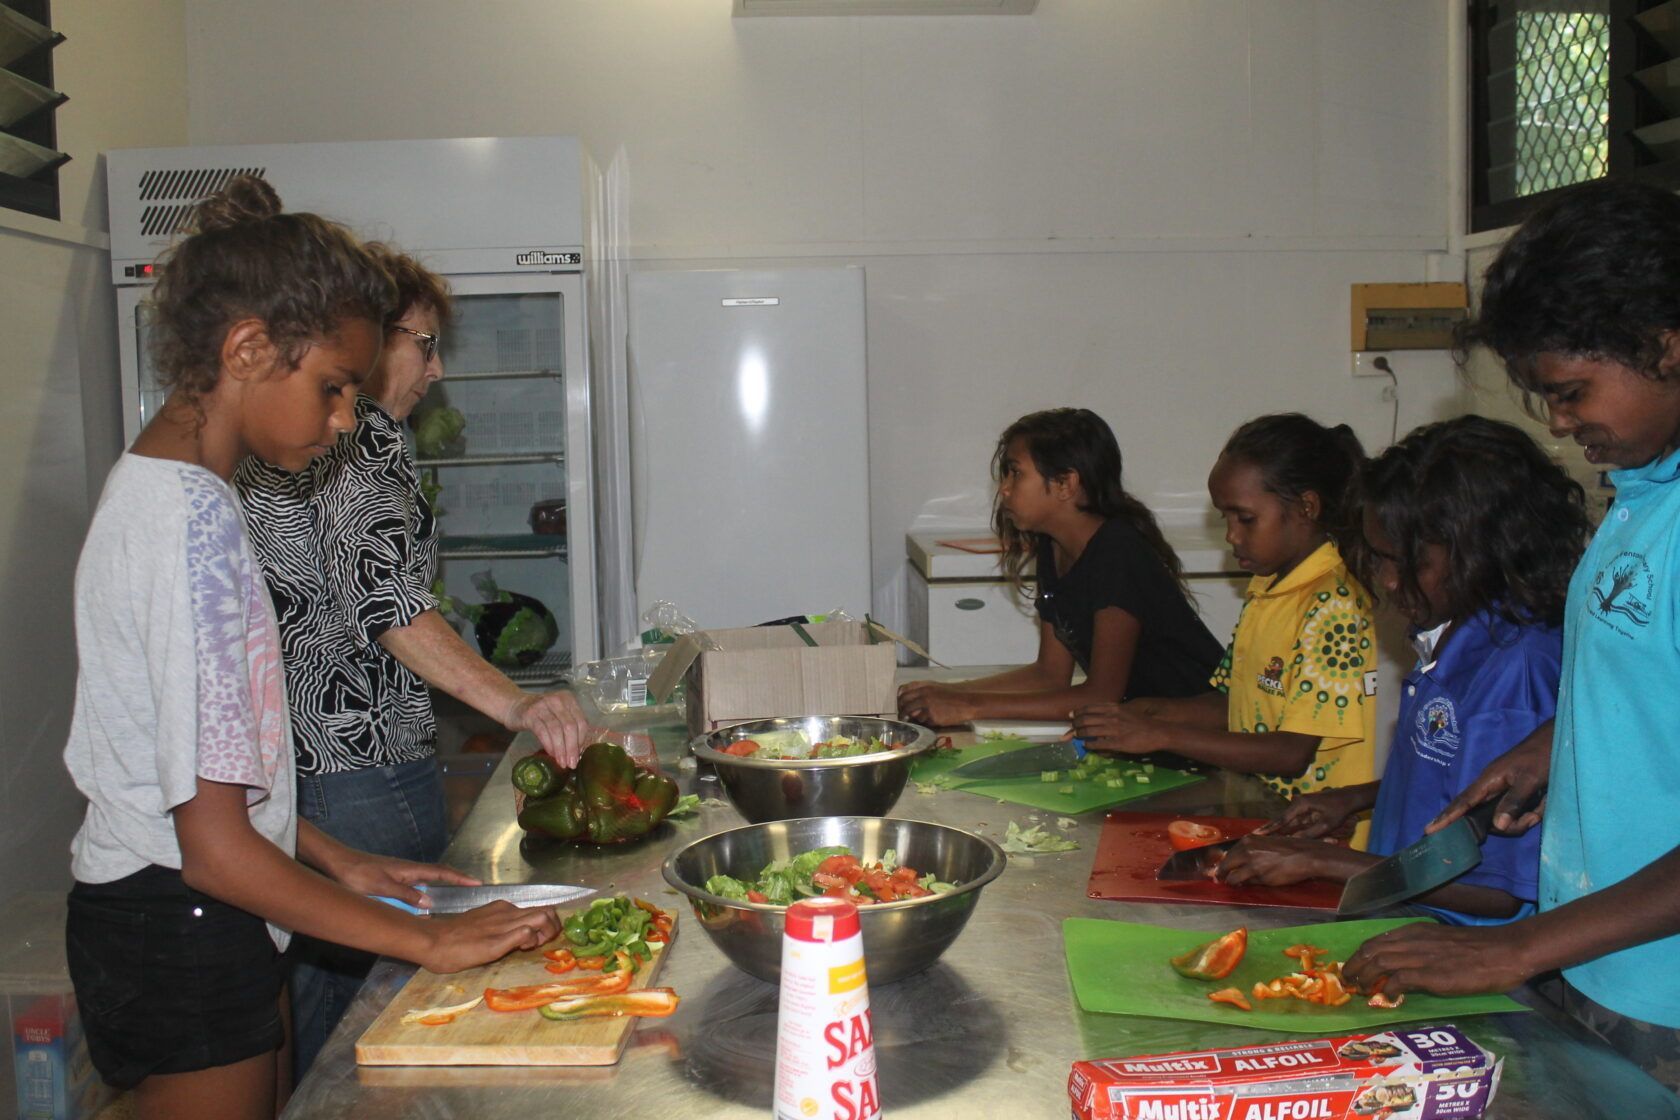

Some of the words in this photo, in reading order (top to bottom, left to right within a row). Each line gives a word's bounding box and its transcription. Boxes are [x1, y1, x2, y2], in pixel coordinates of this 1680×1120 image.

[518, 252, 572, 264] williams
[1407, 1031, 1457, 1048] 30
[1232, 1048, 1266, 1056] STRONG
[1275, 1043, 1314, 1052] RELIABLE
[1123, 1060, 1209, 1073] Multix
[1235, 1052, 1323, 1071] ALFOIL
[1138, 1097, 1221, 1120] Multix
[1244, 1098, 1332, 1120] ALFOIL
